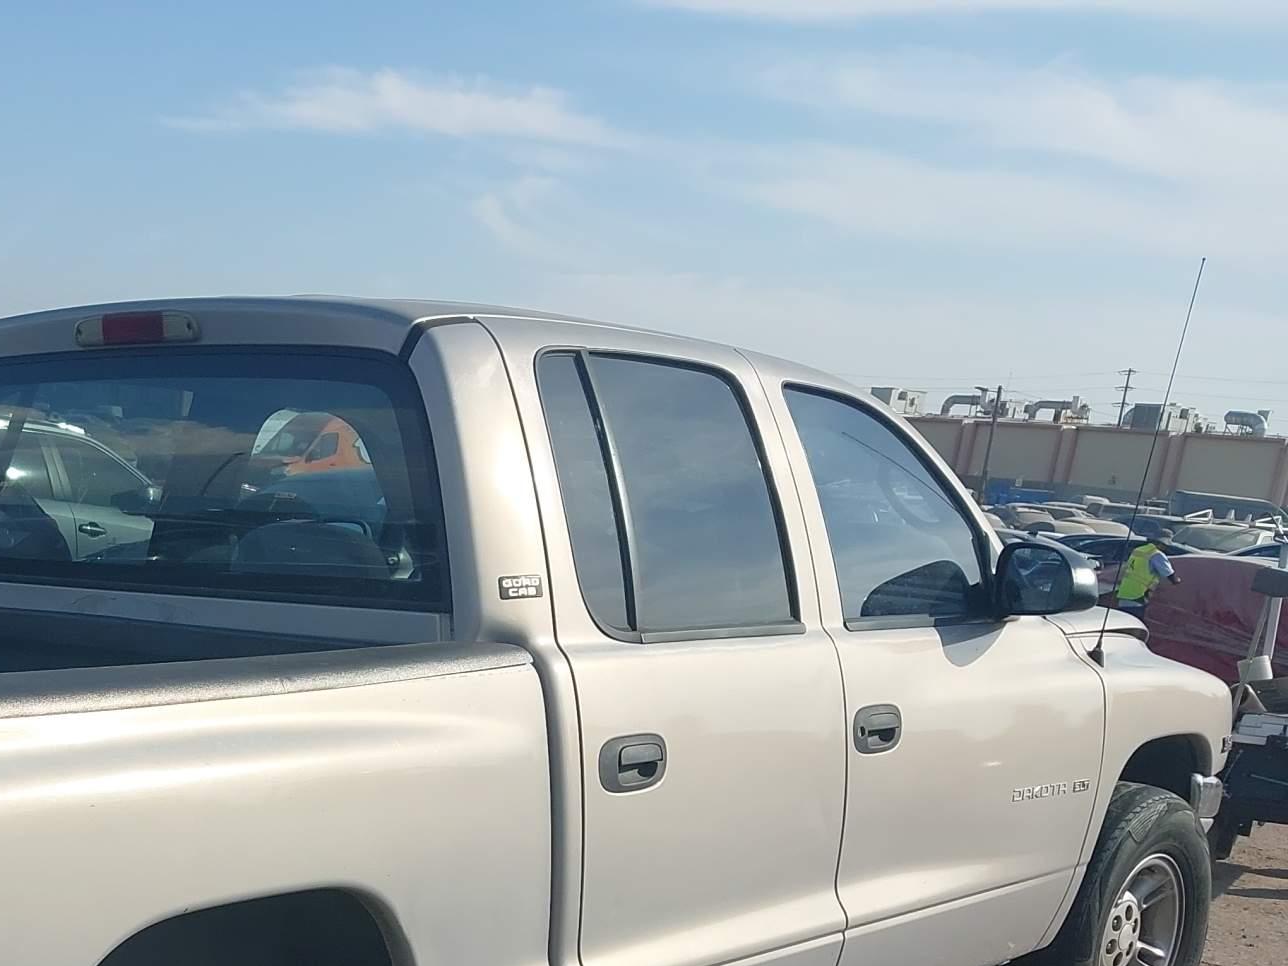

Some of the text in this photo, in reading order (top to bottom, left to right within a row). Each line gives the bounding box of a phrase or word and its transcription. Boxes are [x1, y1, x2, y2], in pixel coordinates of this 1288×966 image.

[508, 586, 537, 597] CAB
[1012, 780, 1090, 802] DAKOTA SLT
